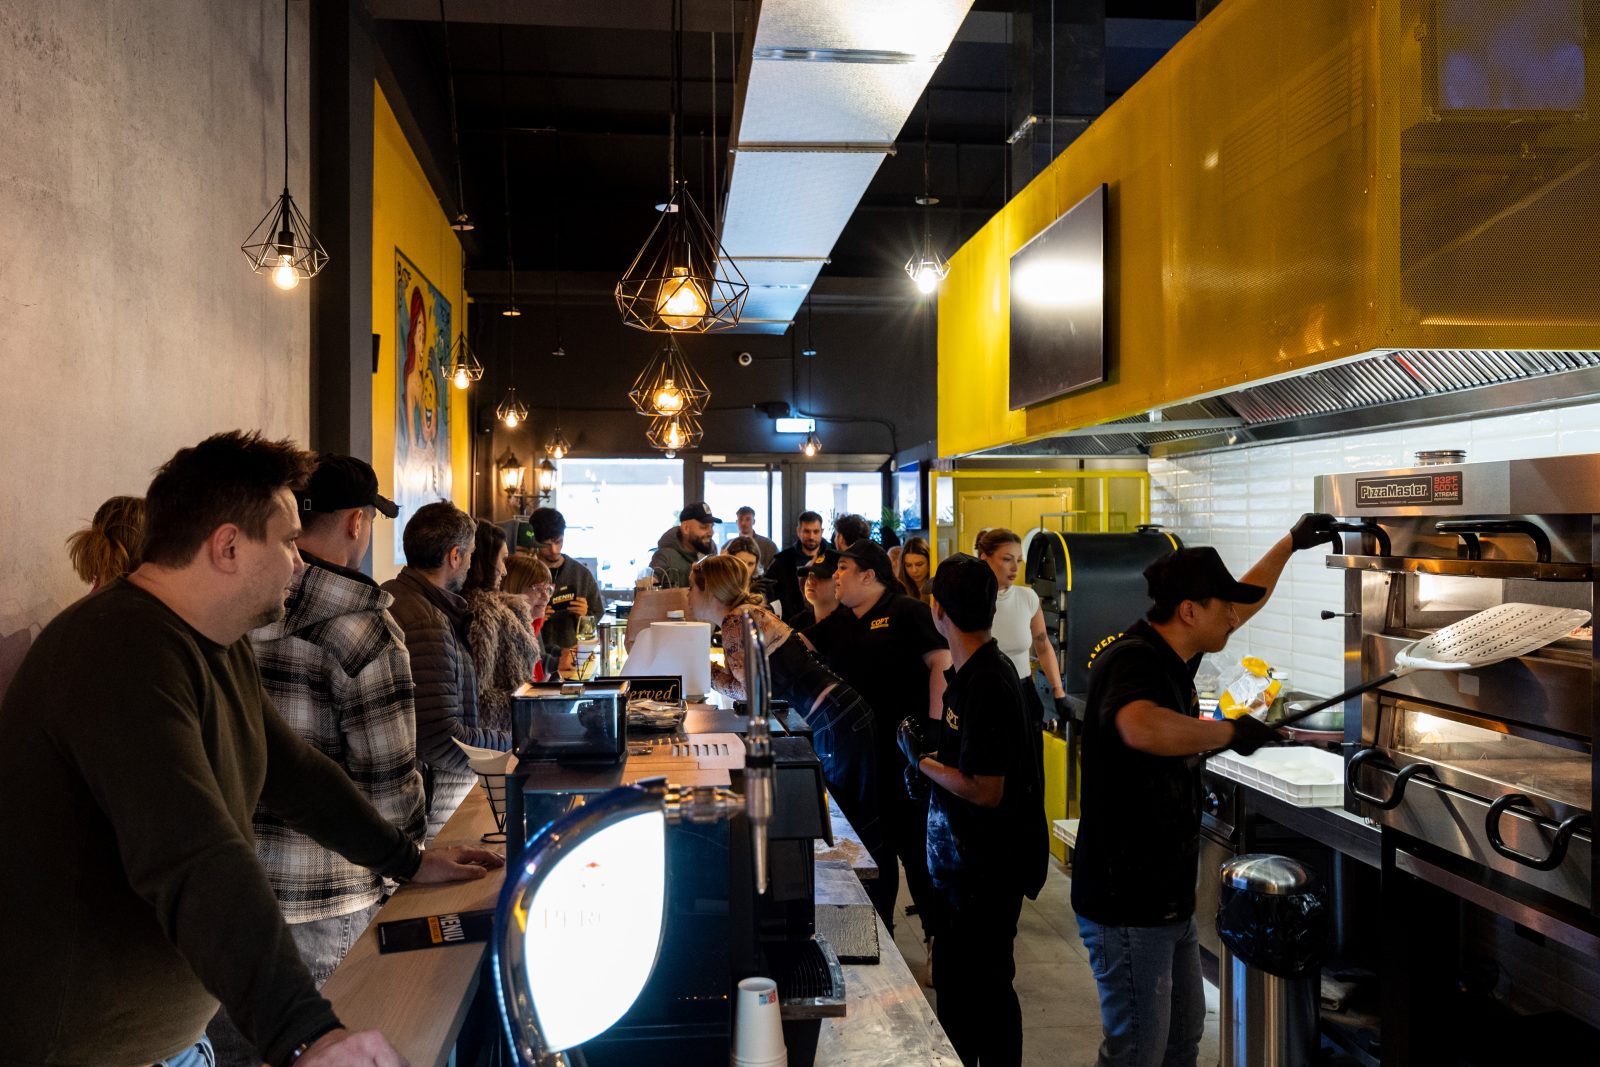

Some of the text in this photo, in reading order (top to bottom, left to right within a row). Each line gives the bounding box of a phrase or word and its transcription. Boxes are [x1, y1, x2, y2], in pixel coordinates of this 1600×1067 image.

[1361, 483, 1427, 499] PizzaMaster
[630, 684, 677, 700] erved
[439, 913, 465, 942] MENIU
